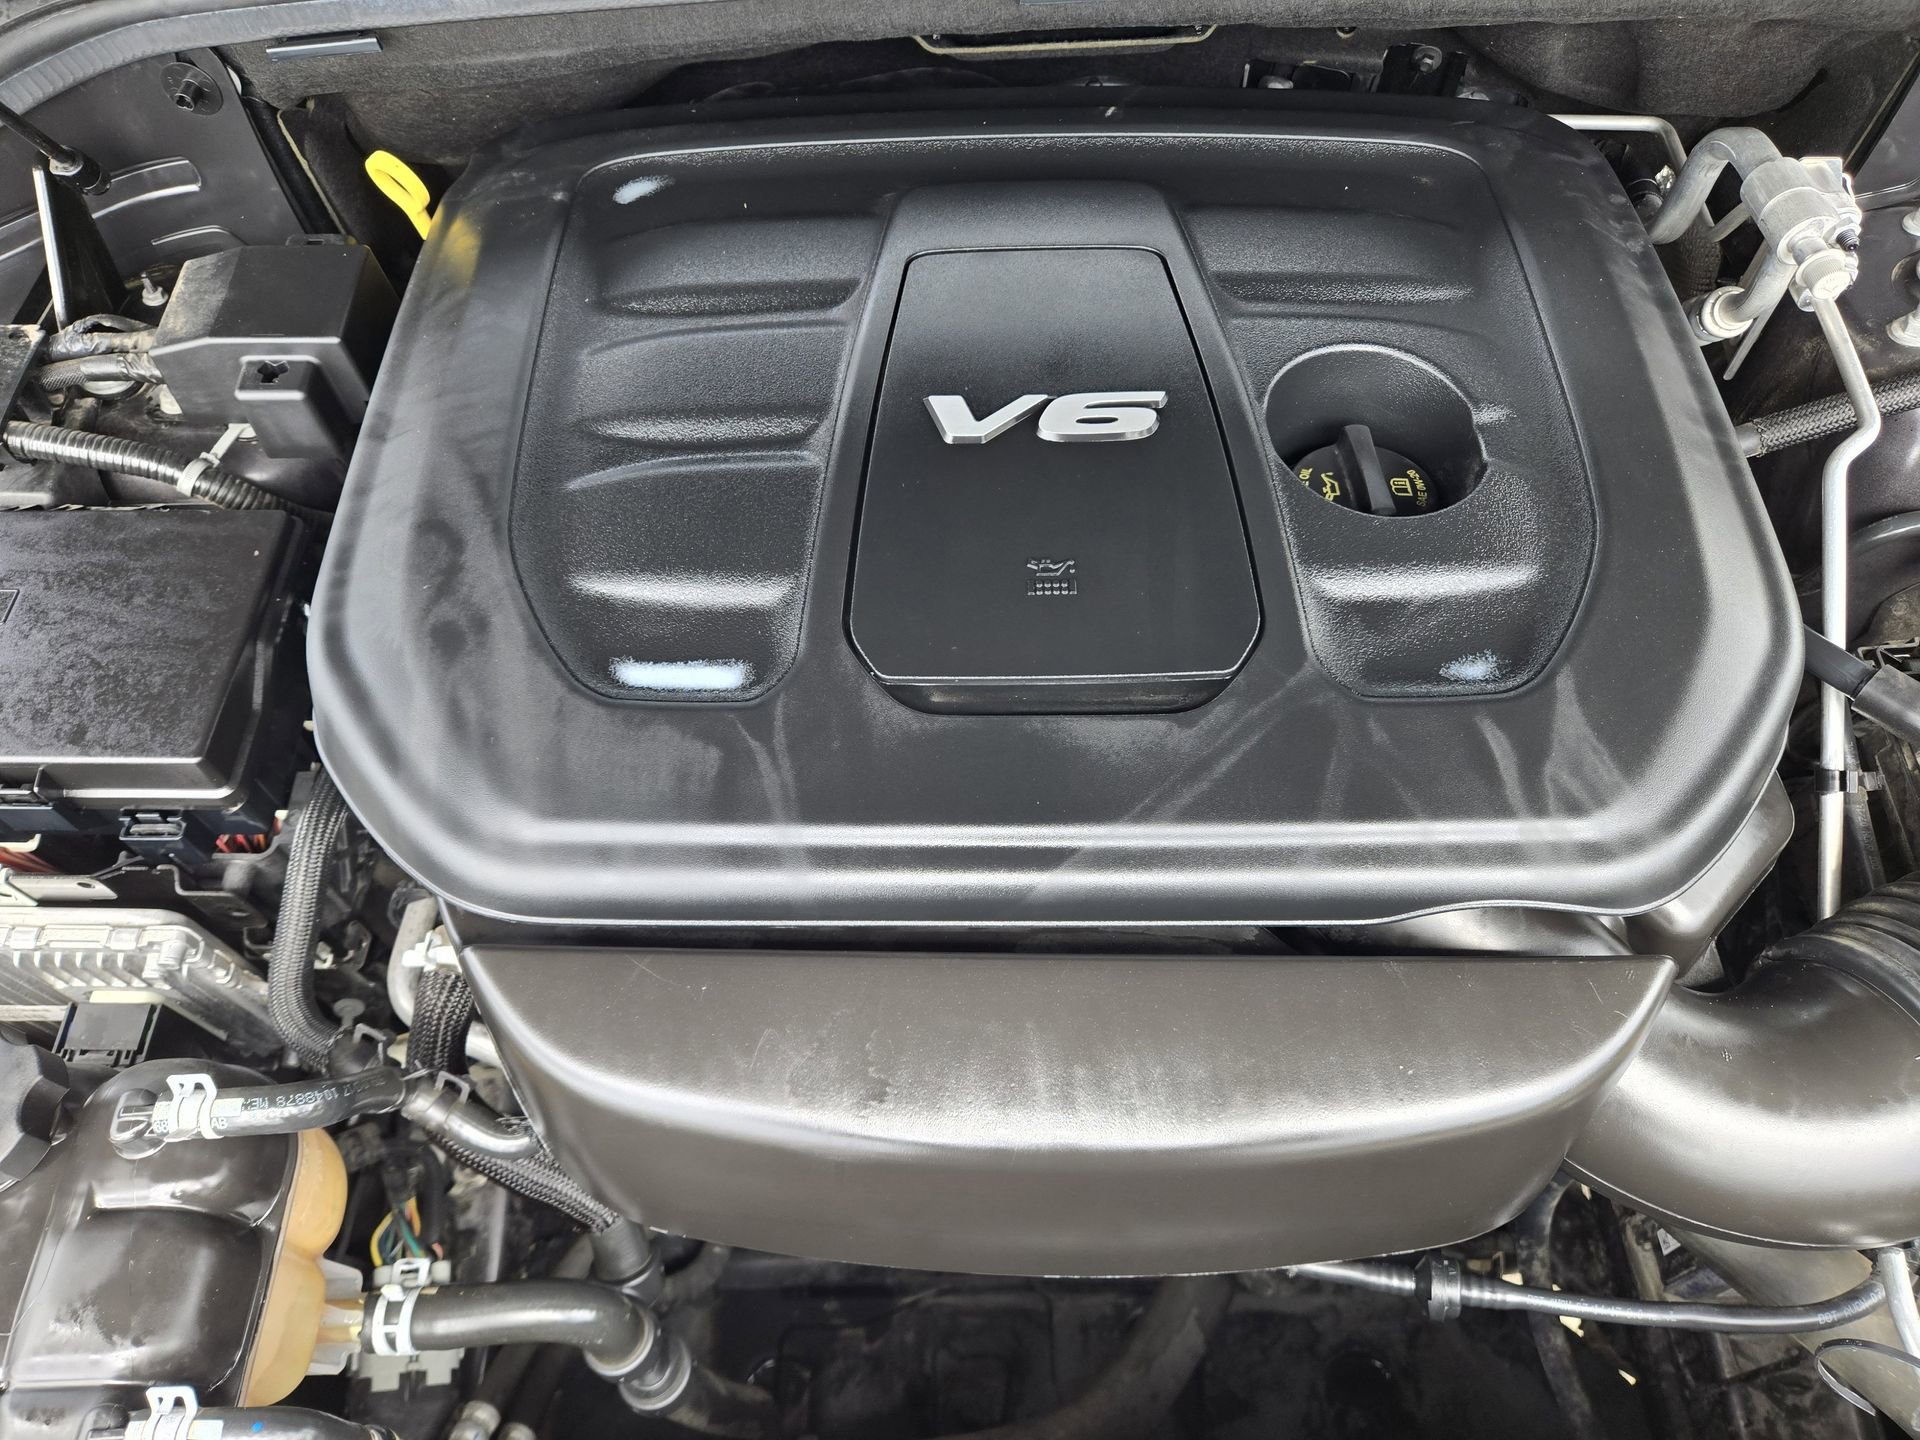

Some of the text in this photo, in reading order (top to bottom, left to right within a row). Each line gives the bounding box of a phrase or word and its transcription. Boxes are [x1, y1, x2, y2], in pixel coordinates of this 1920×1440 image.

[923, 391, 1168, 444] V6
[1299, 467, 1313, 480] OIL
[1416, 490, 1428, 507] SAE
